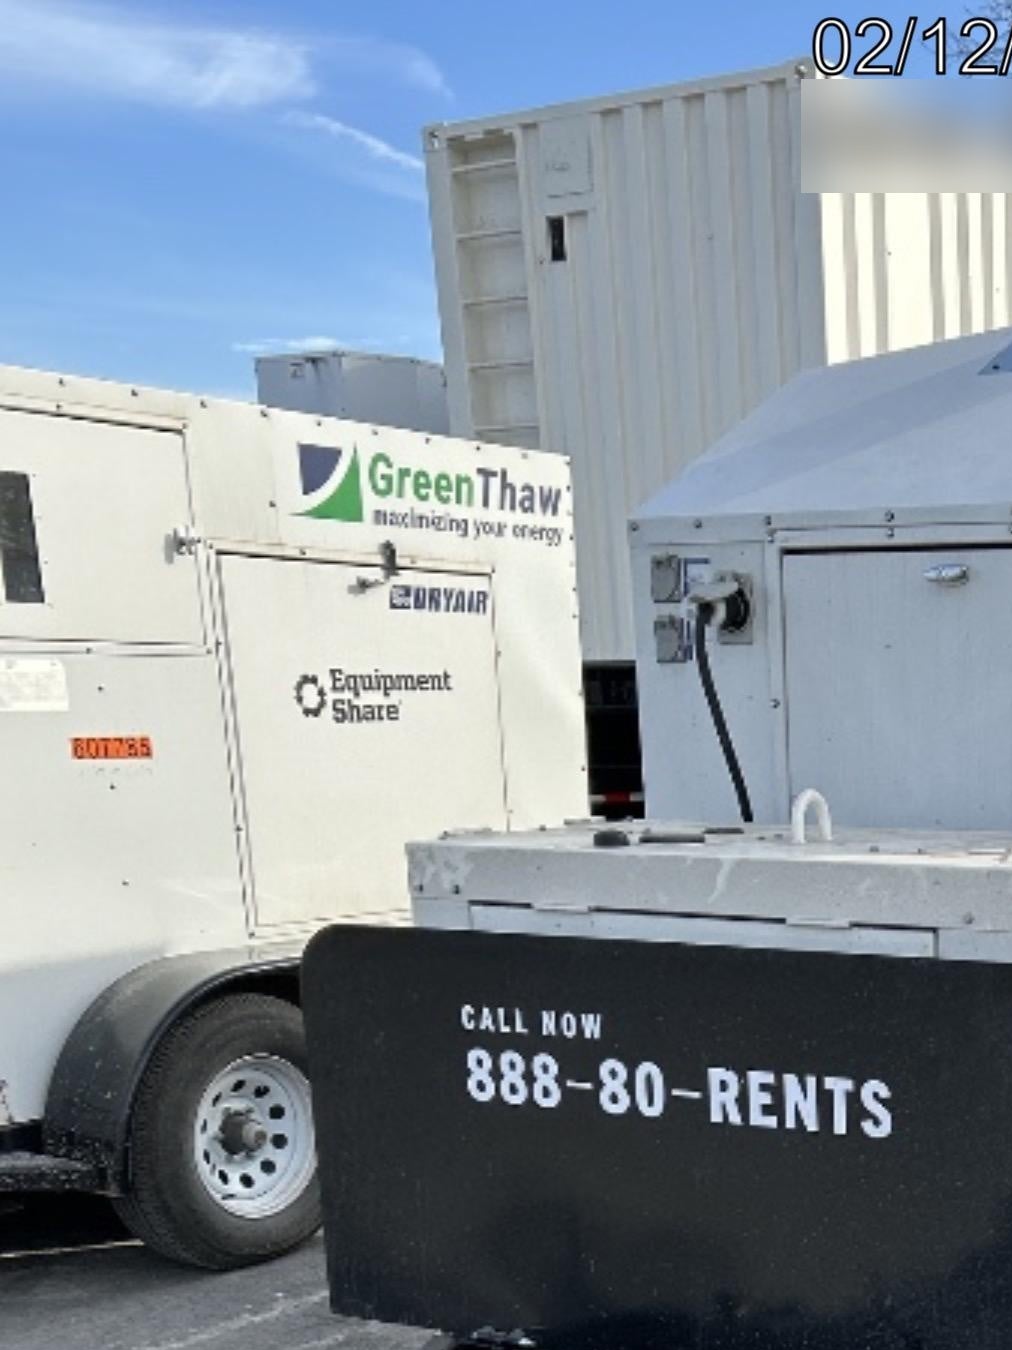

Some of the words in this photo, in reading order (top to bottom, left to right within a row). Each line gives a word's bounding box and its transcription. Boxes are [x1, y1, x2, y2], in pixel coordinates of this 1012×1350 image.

[368, 452, 562, 516] GreenThaw
[373, 507, 469, 538] maximizing
[473, 518, 508, 541] your
[512, 523, 565, 547] energy
[329, 668, 453, 698] Equipment
[332, 698, 401, 723] Share
[461, 1004, 529, 1034] CALL
[541, 1010, 602, 1040] NOW
[466, 1046, 894, 1139] 888-80-RENTS
